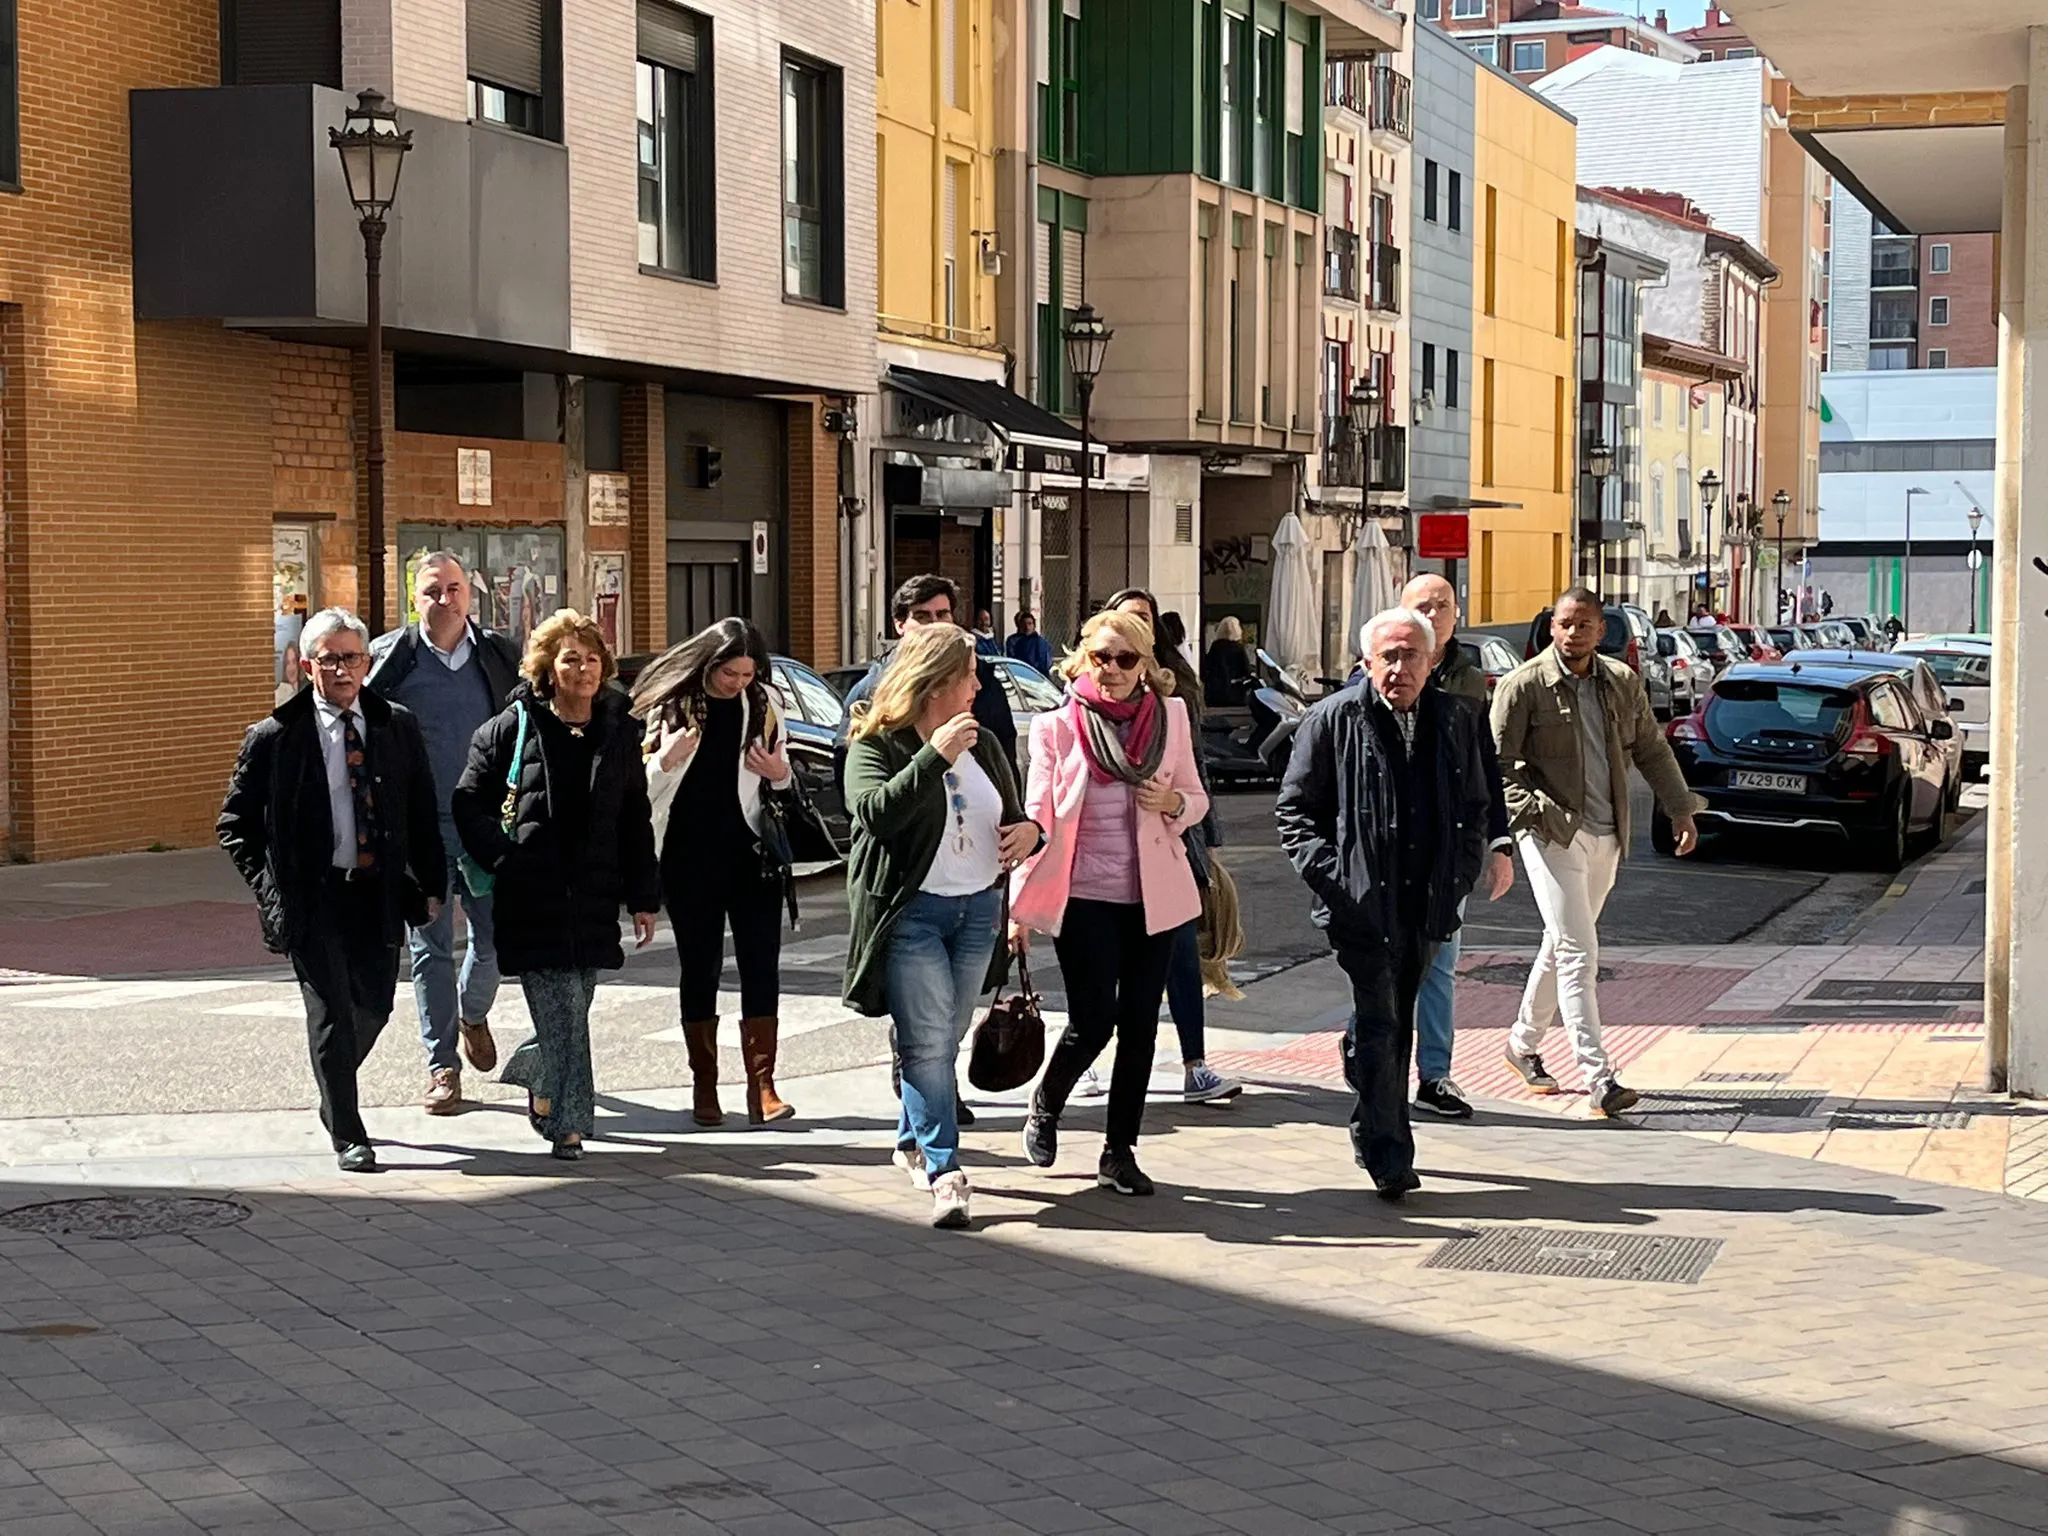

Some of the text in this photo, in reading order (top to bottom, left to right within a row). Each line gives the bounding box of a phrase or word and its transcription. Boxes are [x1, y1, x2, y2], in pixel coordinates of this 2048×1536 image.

[1733, 738, 1814, 749] VOLVO
[1739, 773, 1802, 789] 7429 GXK
